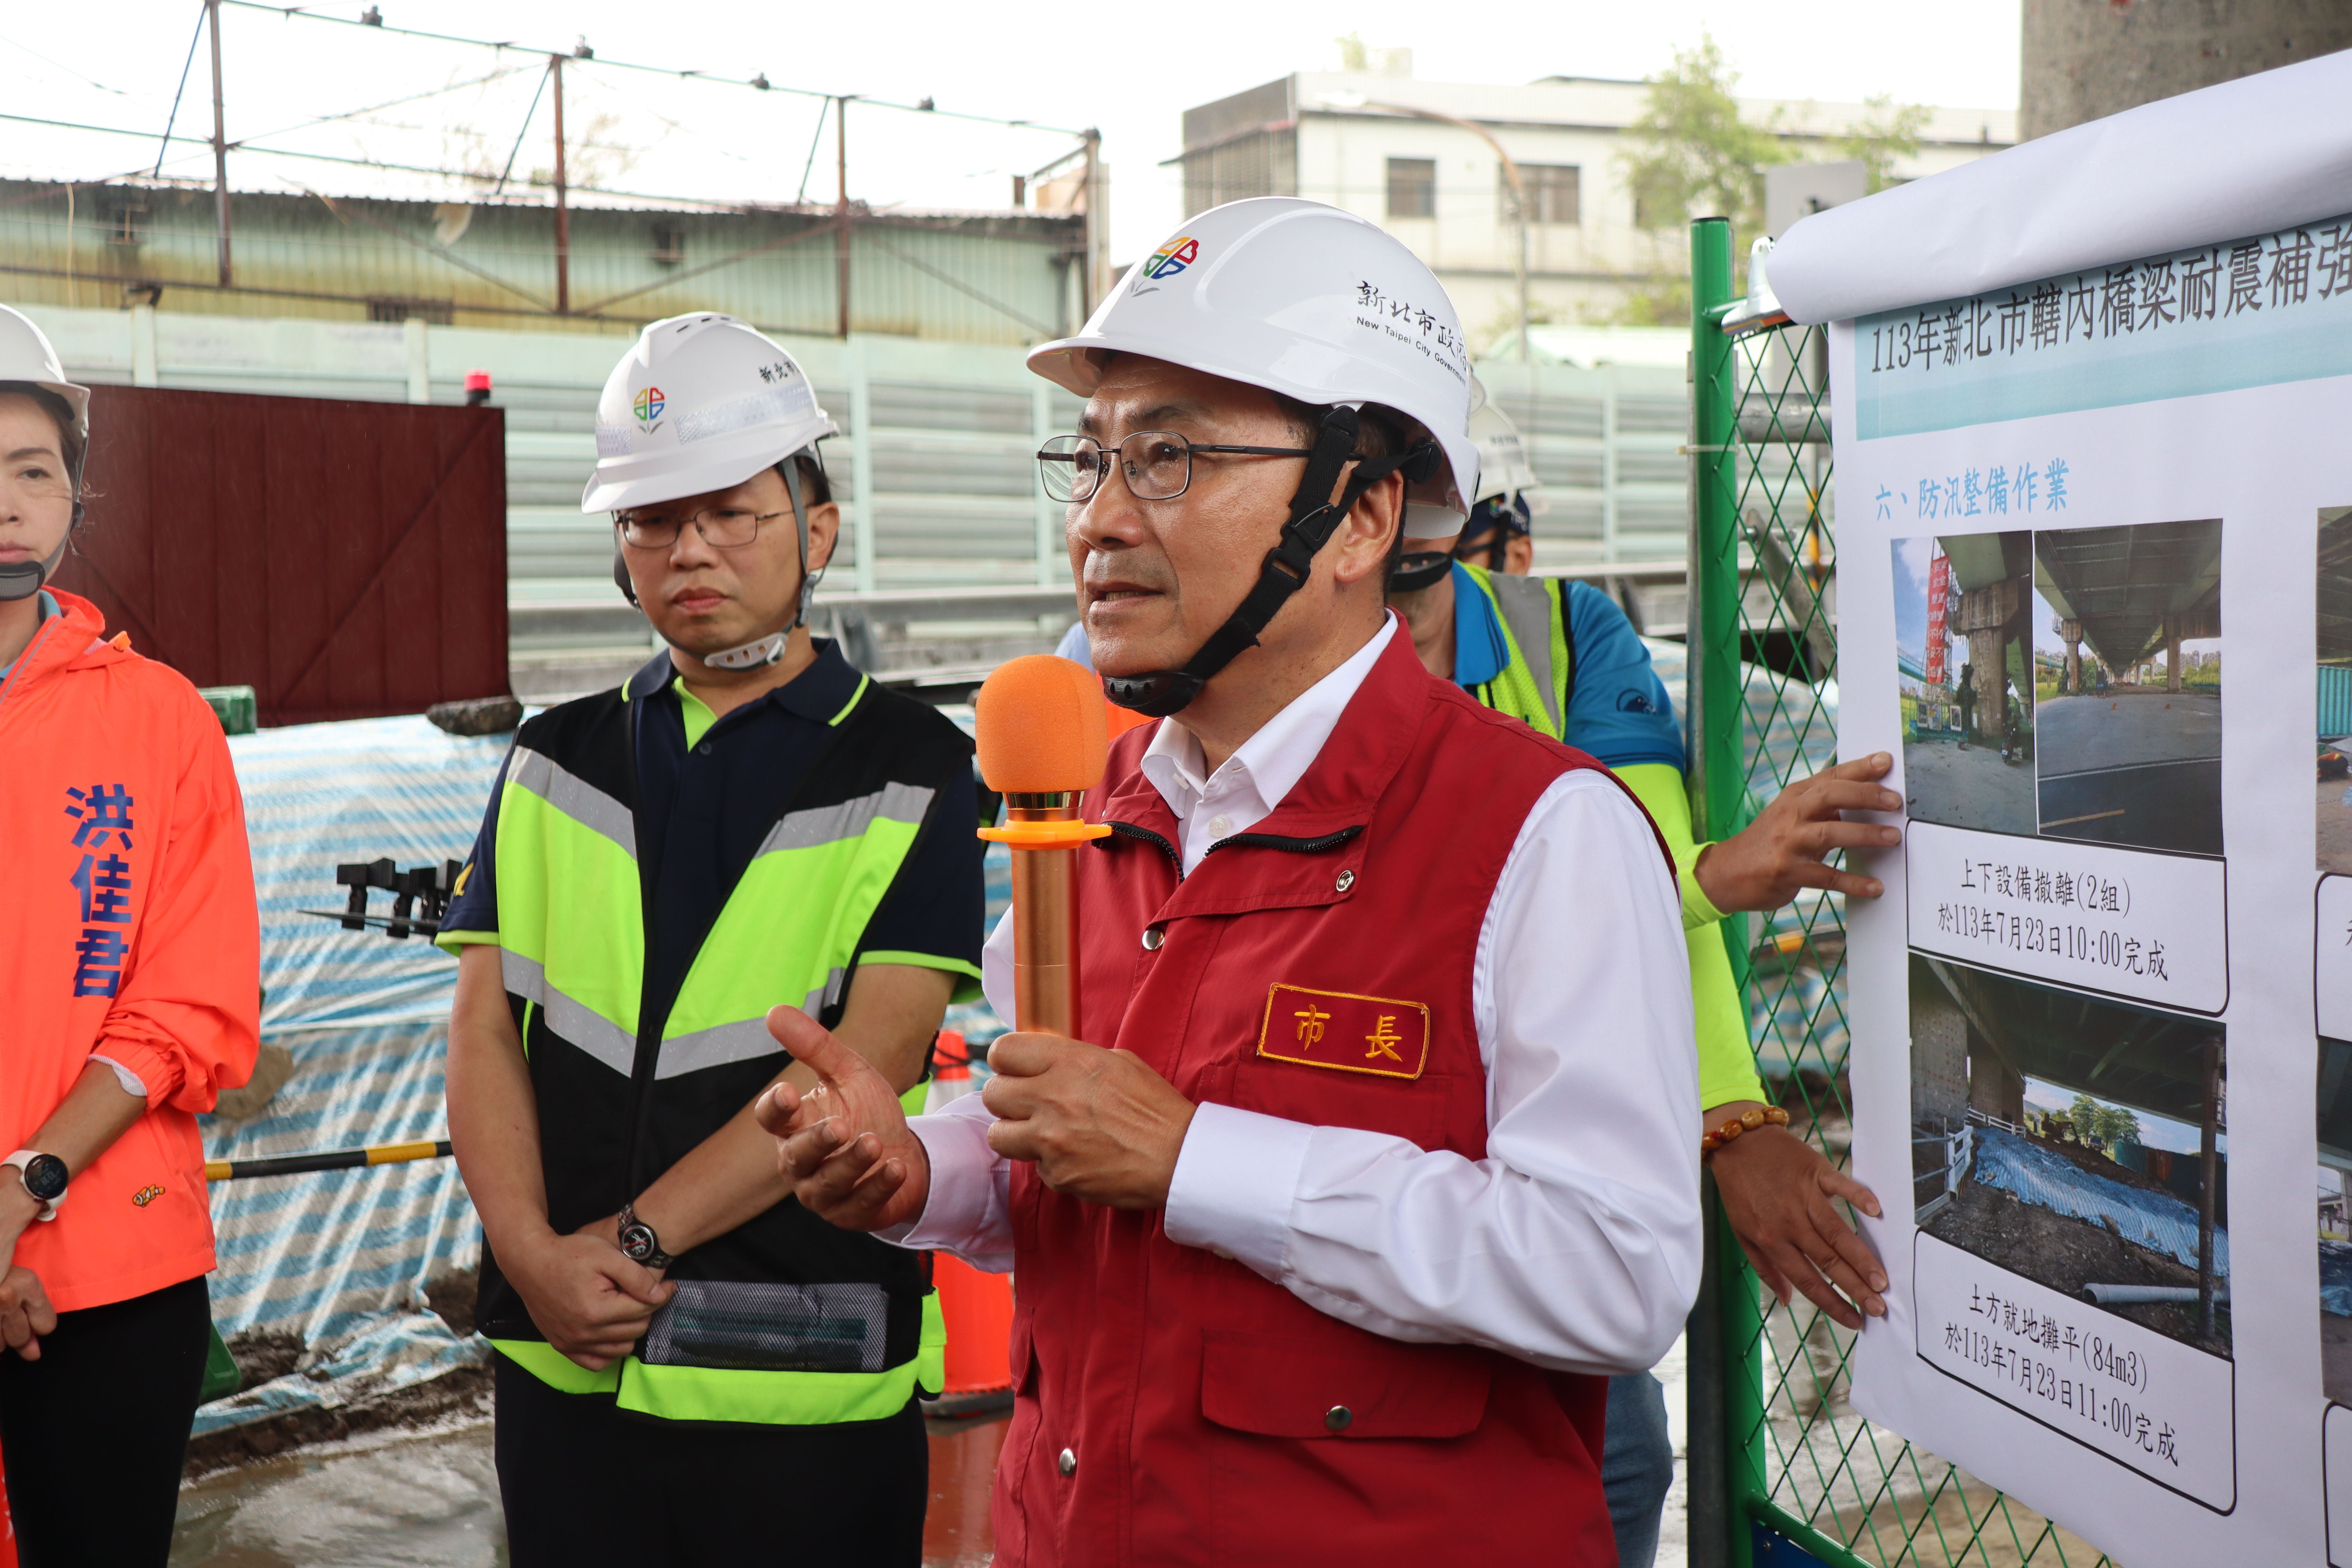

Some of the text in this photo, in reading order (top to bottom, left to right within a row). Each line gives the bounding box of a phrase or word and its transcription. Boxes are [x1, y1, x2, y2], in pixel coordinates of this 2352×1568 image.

[1872, 221, 2352, 373] 113年新北市轄內橋梁耐震補強
[1356, 316, 1466, 387] New Taipei City Government
[1875, 457, 2069, 521] 六、防汛整備作業
[64, 783, 134, 999] 洪佳君
[1960, 858, 2131, 919] 上下設備撤離(2組)
[1938, 902, 2168, 982] 於113年7月23日10:00完成
[1969, 1283, 2147, 1394] 土方就地攤平(84m3)
[1944, 1321, 2178, 1467] 於113年7月23日11:00完成
